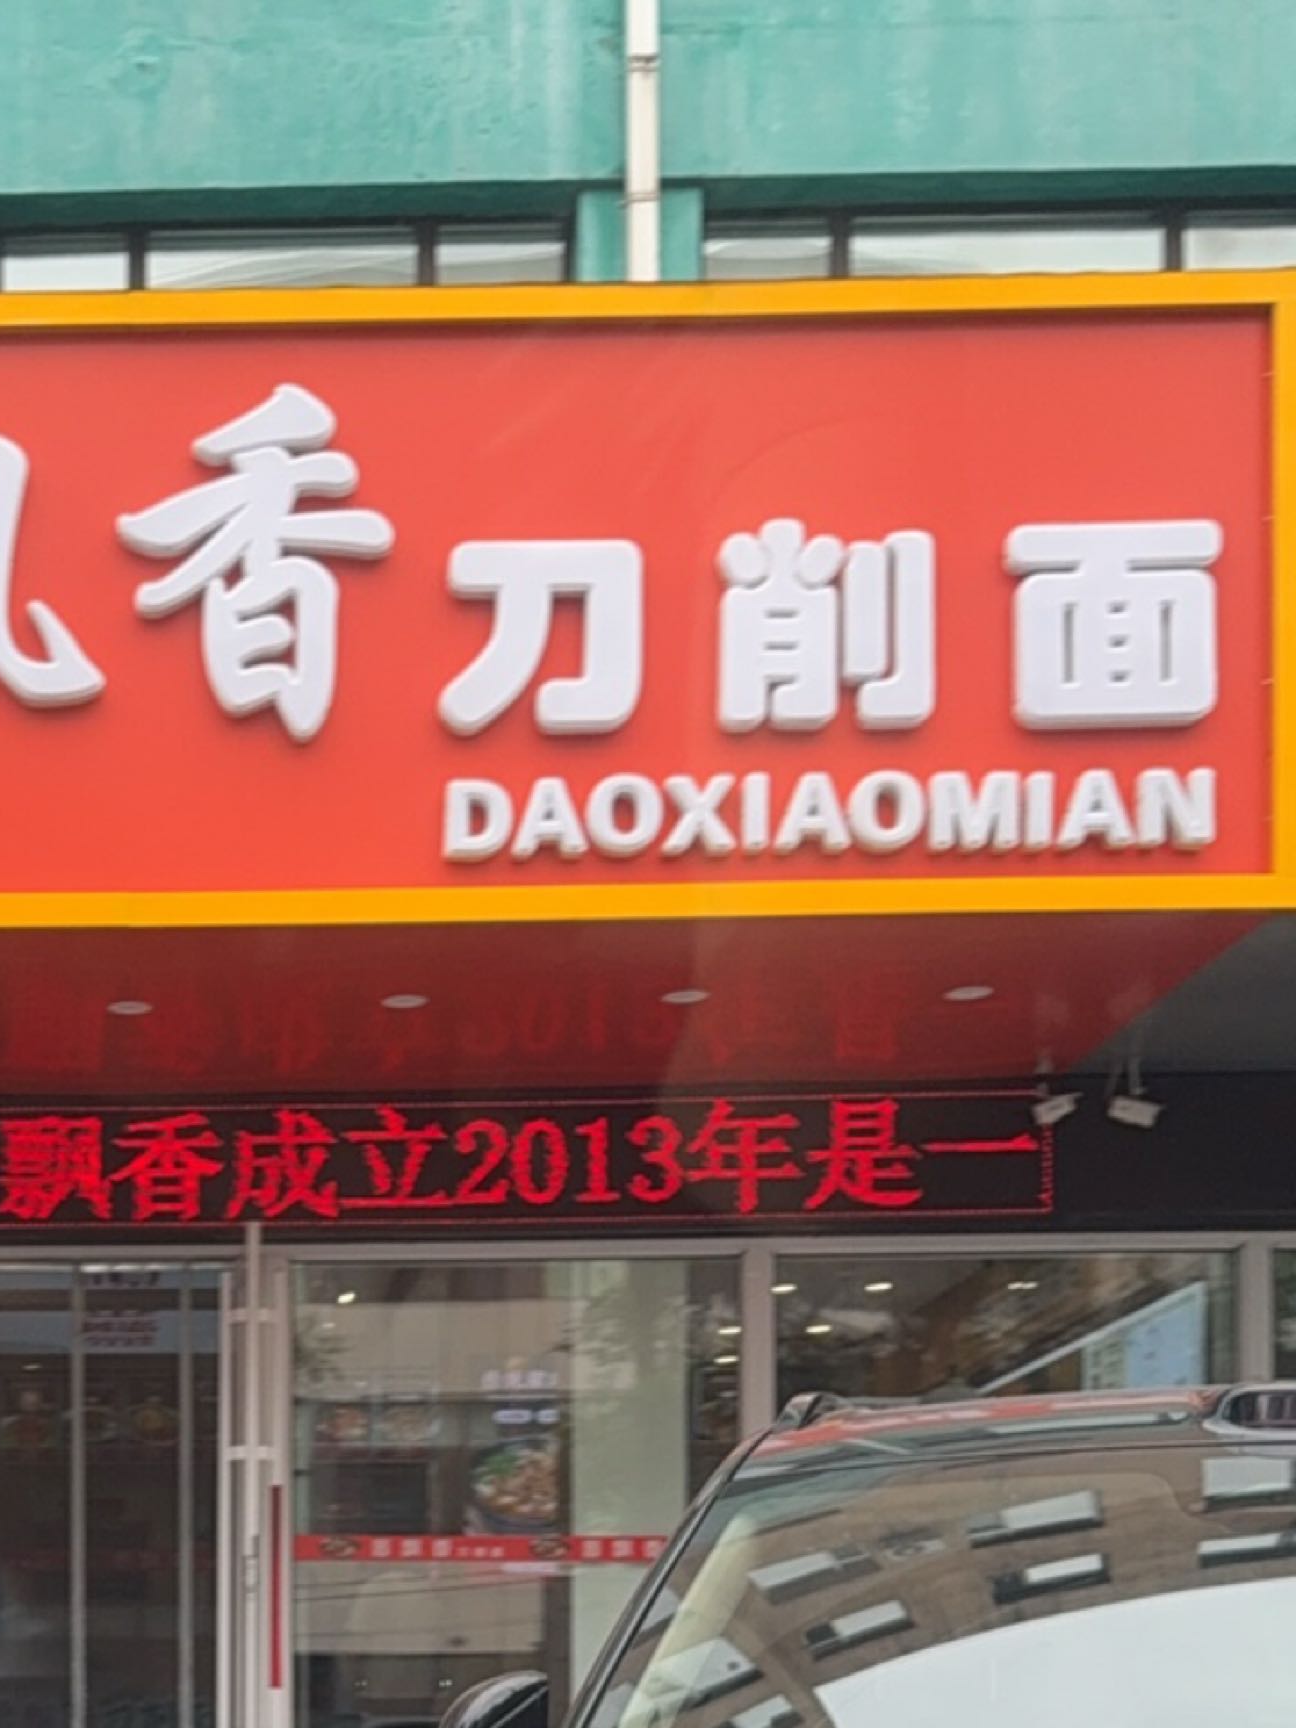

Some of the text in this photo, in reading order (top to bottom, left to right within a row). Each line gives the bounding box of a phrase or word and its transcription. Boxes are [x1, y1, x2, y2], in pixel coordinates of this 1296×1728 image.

[438, 519, 1223, 735] 刀削面
[443, 768, 1216, 861] DAOXIAOMIAN
